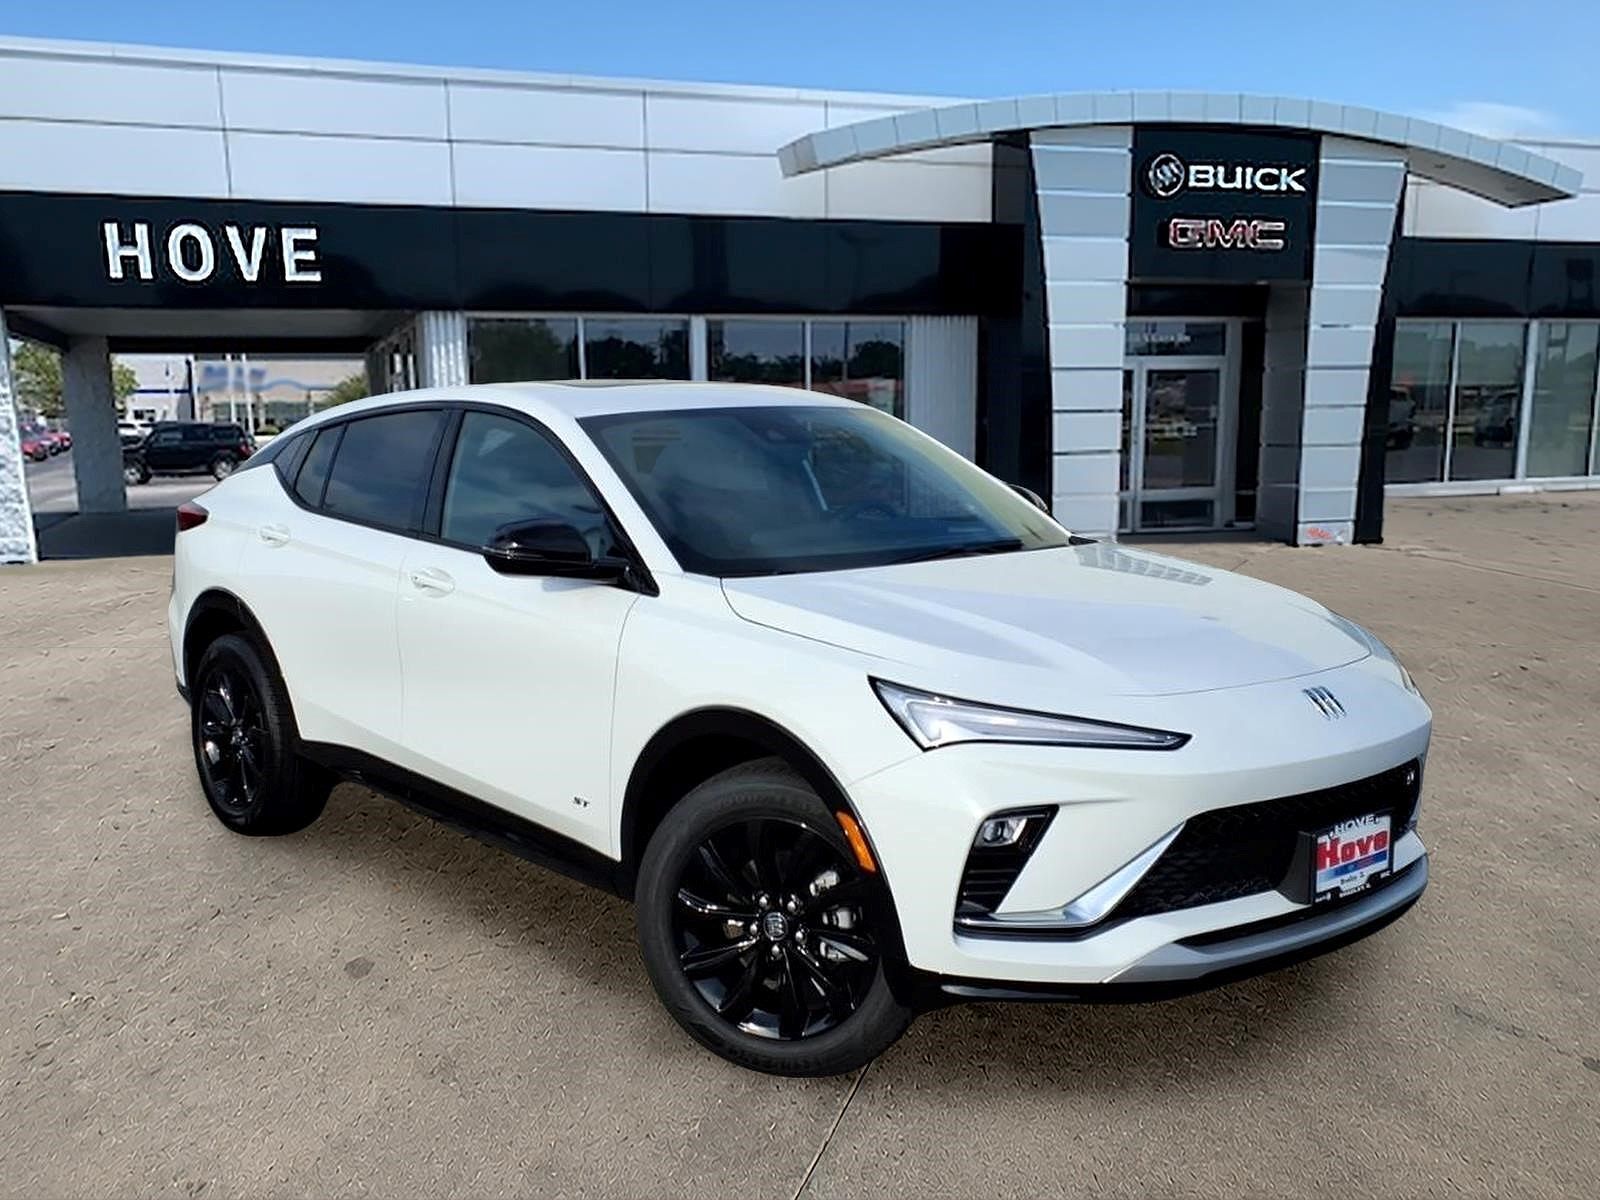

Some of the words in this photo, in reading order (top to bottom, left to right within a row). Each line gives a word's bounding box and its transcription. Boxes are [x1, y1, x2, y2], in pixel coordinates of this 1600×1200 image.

[1188, 165, 1306, 191] BUICK
[1168, 217, 1285, 250] GMC
[104, 222, 322, 282] HOVE
[1317, 830, 1388, 870] Hove
